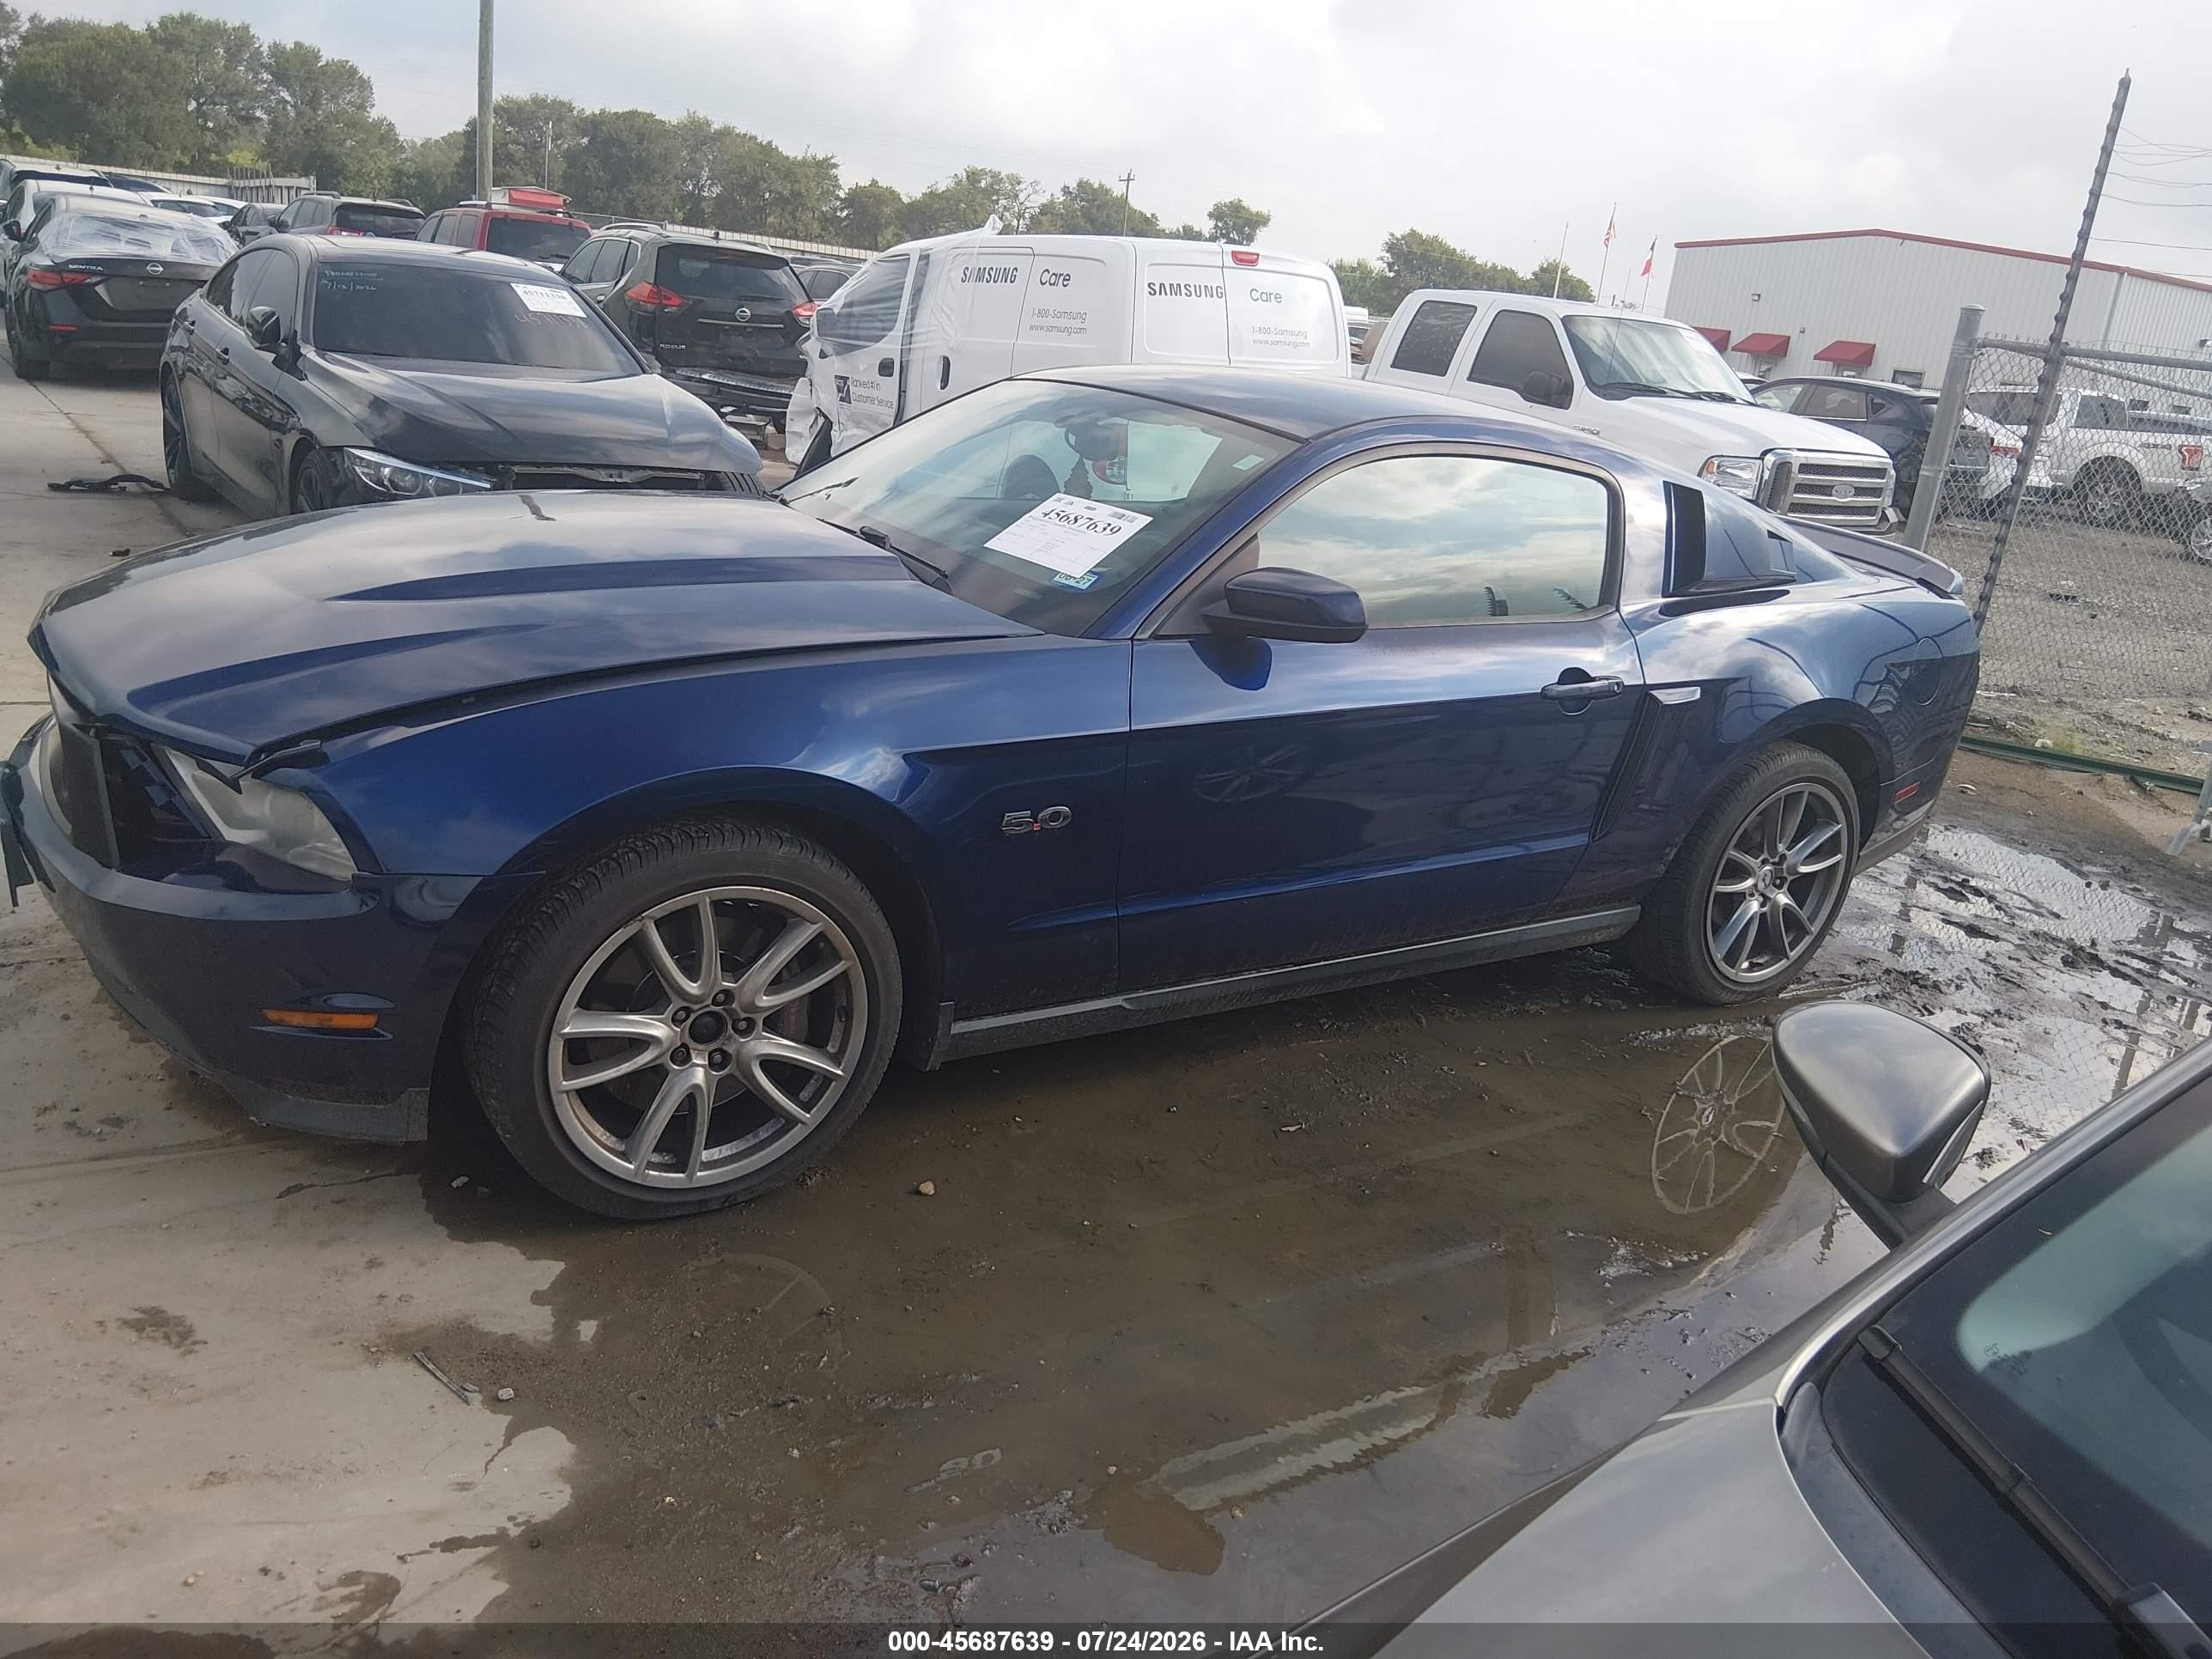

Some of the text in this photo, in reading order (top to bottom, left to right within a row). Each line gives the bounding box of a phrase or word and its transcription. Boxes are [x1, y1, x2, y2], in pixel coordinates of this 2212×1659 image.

[961, 266, 1071, 287] SAMSUNG Care
[1147, 282, 1283, 303] SAMSUNG Care
[1031, 307, 1087, 324] 1-800-Samsung
[1029, 323, 1087, 337] www.samsung.com
[1252, 326, 1308, 339] 1-800-Samsung
[1252, 338, 1311, 349] www.samsung.com
[876, 396, 894, 410] Service
[1041, 508, 1122, 537] 45687639
[1001, 806, 1073, 834] 5.0
